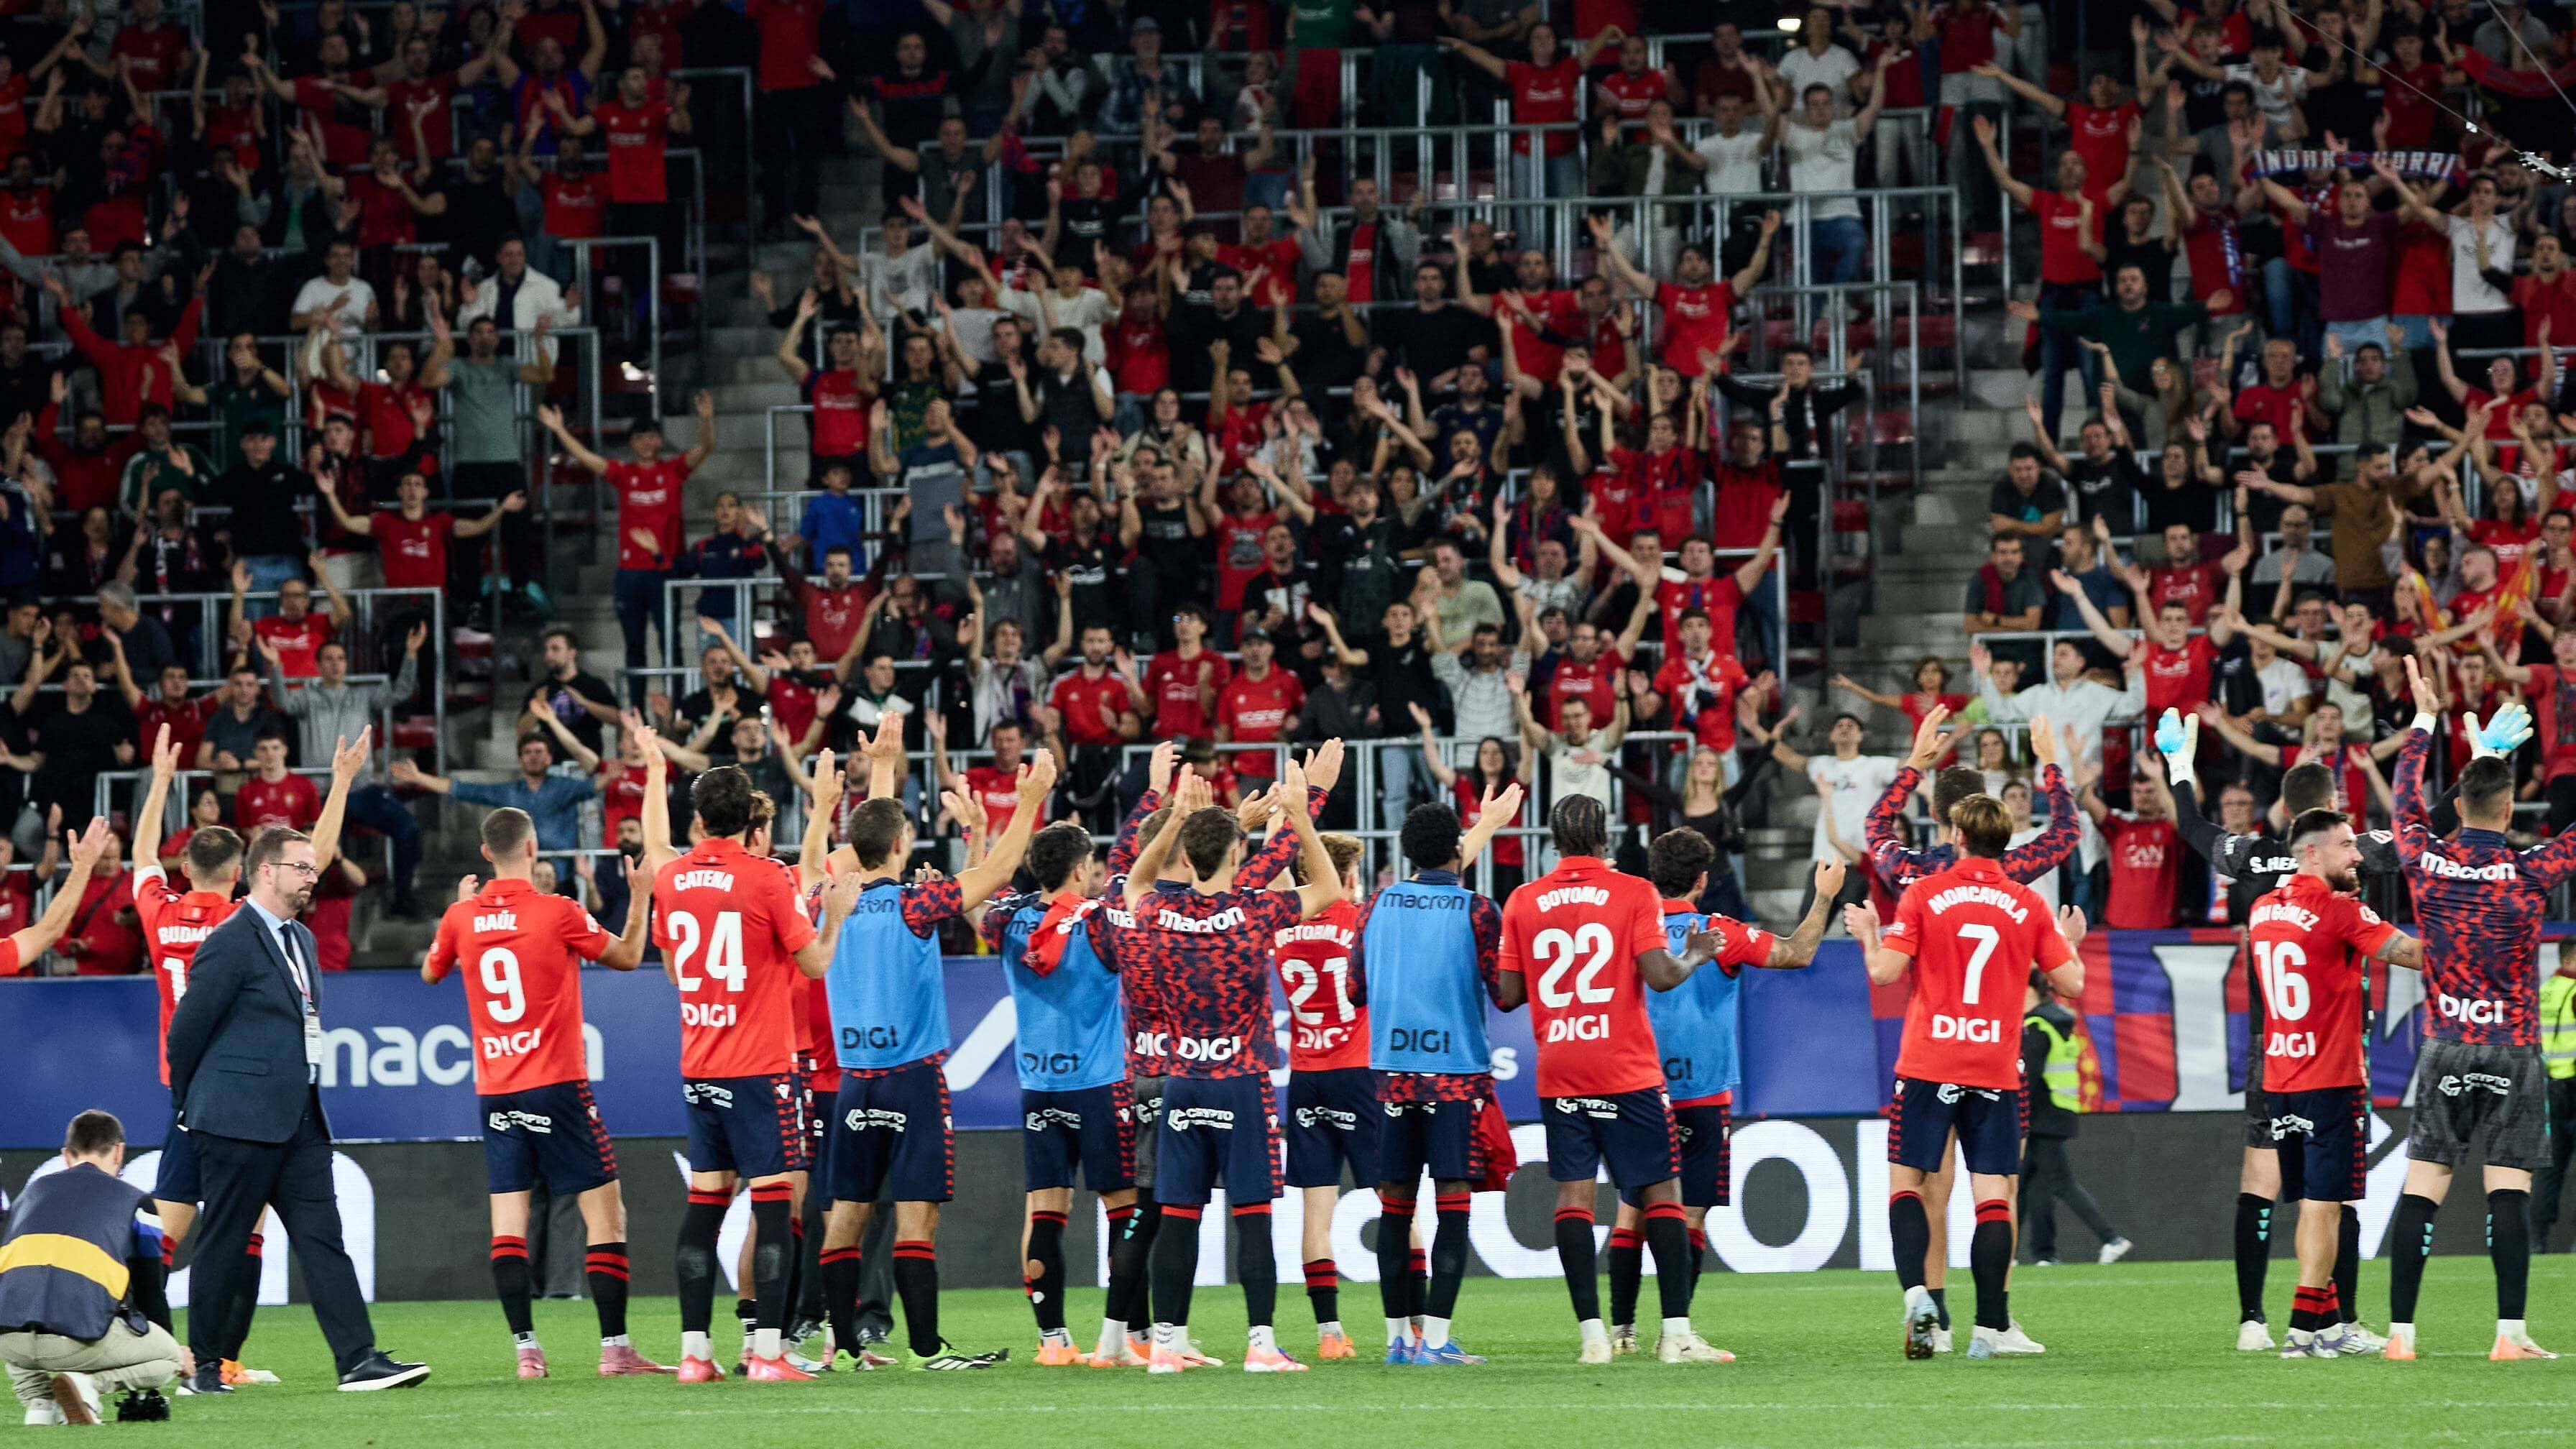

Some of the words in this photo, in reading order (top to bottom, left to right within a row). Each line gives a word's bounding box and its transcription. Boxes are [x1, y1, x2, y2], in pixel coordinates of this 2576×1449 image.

[2420, 851, 2516, 880] macron
[673, 872, 735, 893] CATENA
[1383, 893, 1466, 910] macron
[1536, 886, 1610, 913] BOYOMO
[1928, 886, 2029, 924] MONCAYOLA
[473, 909, 518, 933] RAÚL
[1159, 906, 1246, 933] macron
[667, 911, 748, 992] 24
[1532, 922, 1615, 1008] 22
[1957, 923, 2000, 1005] 7
[162, 957, 188, 1005] 1
[479, 947, 525, 1023] 9
[1280, 957, 1356, 1024] 21
[2254, 940, 2310, 1021] 16
[680, 1002, 736, 1028] DIGI
[2438, 993, 2503, 1024] DIGI
[842, 1026, 898, 1049] DIGI
[1391, 1029, 1450, 1053] DIGI
[1546, 1013, 1609, 1043] DIGI
[1931, 1014, 2000, 1043] DIGI
[482, 1028, 541, 1059] DIGI
[1176, 1036, 1241, 1062] DIGI
[1024, 1052, 1080, 1074] DIGI
[1185, 1108, 1235, 1122] CRYPTO
